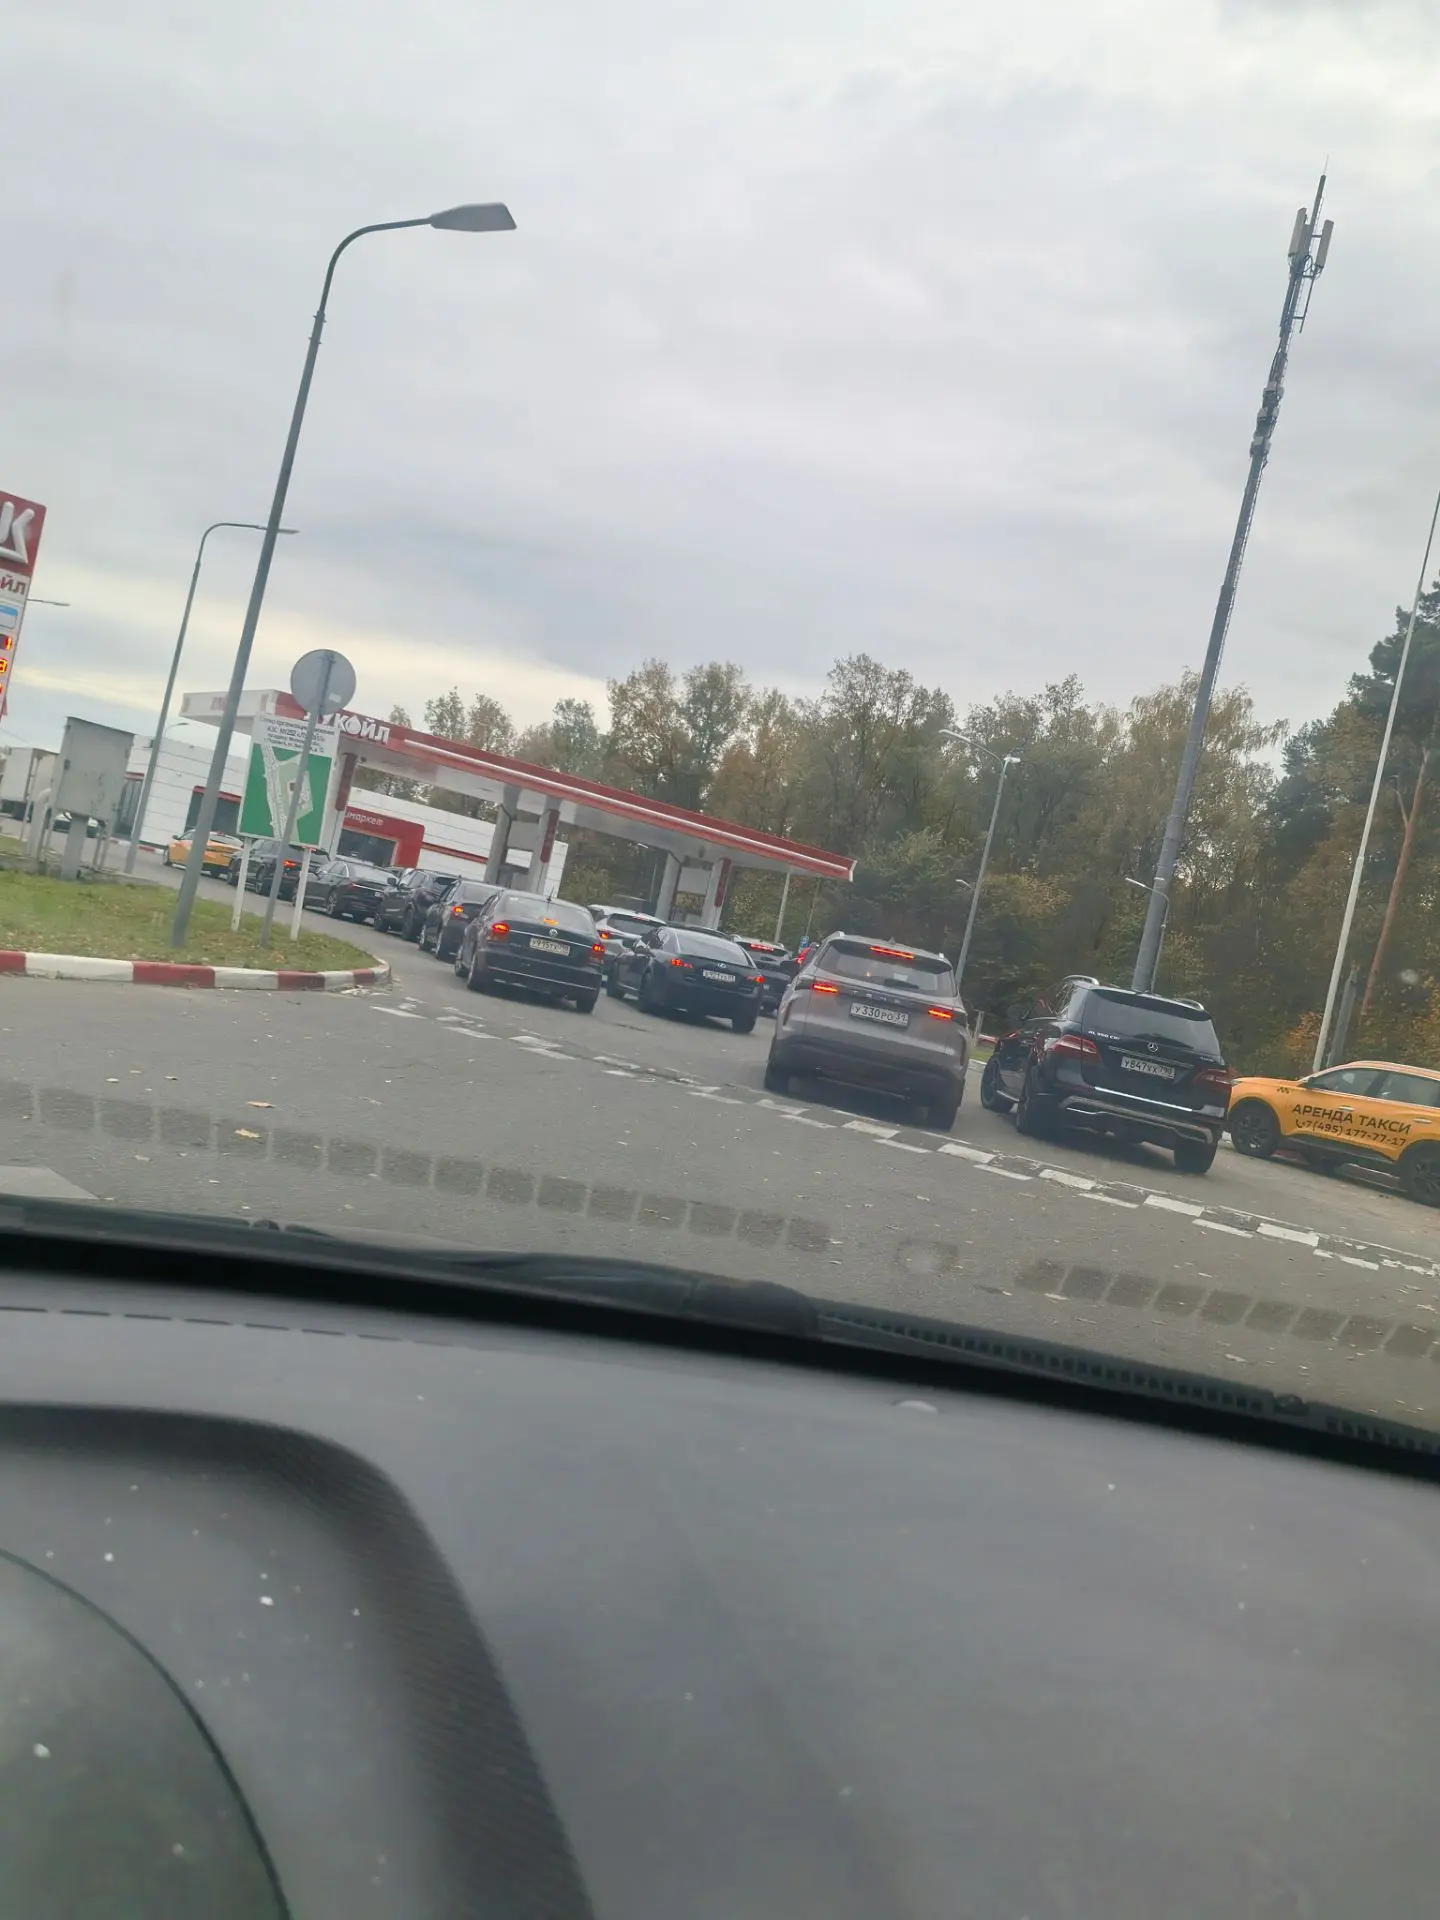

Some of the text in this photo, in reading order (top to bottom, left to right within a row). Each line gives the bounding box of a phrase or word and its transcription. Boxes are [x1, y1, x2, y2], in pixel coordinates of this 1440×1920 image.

[0, 574, 26, 595] ЙЛ
[1291, 1104, 1412, 1135] АРЕНДА ТАКСИ
